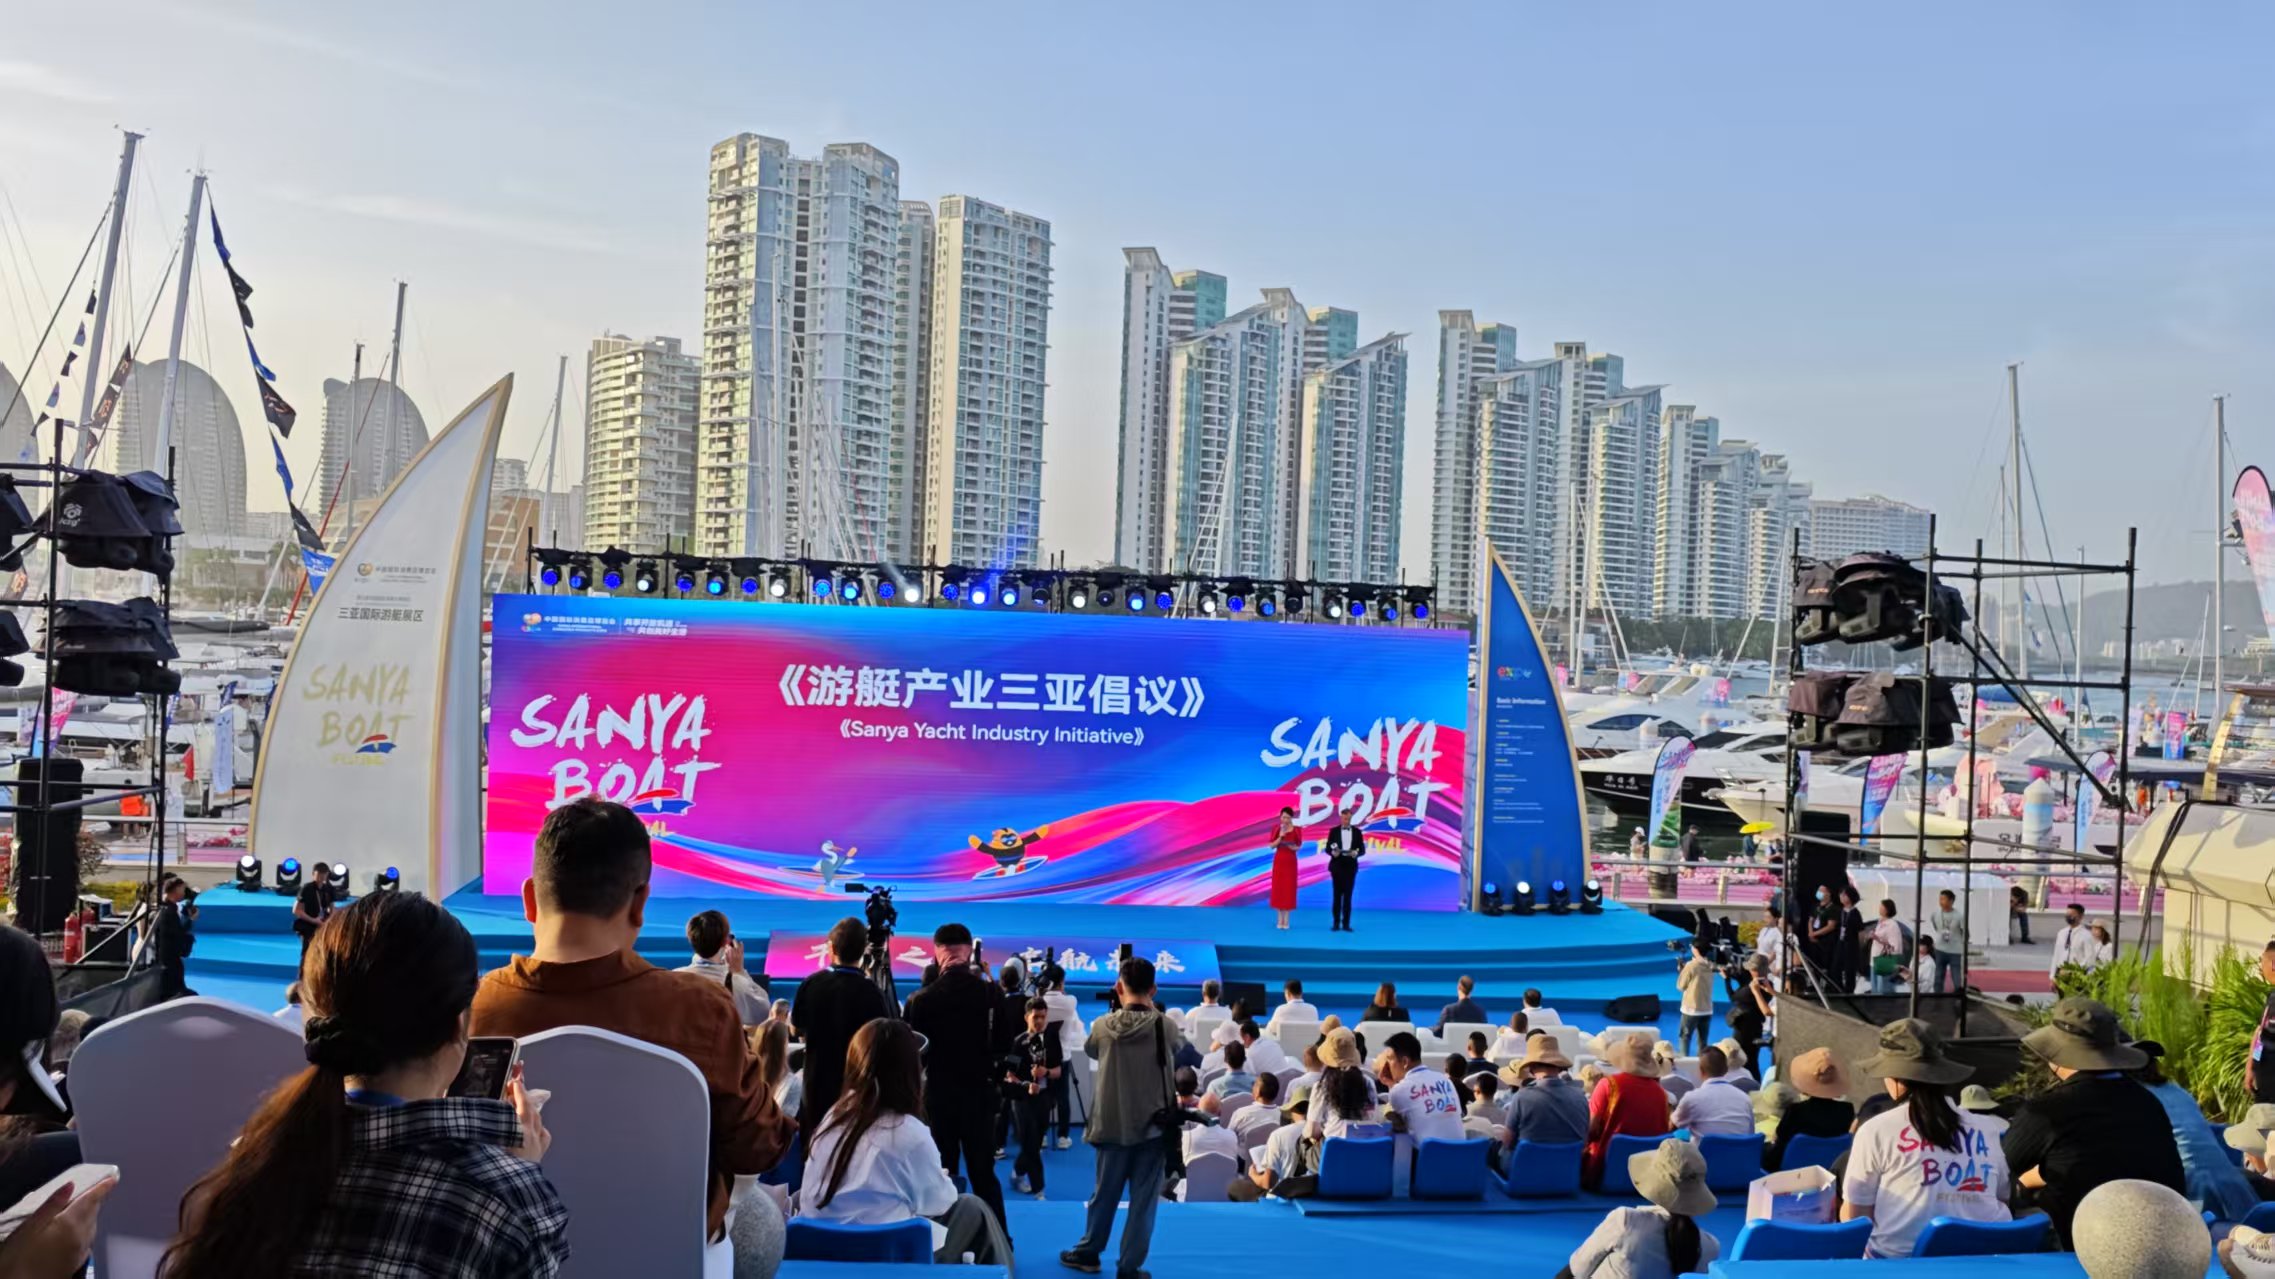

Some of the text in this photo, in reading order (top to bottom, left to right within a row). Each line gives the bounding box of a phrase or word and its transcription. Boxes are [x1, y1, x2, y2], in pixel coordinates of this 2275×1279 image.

[338, 607, 424, 622] 三亚国际游艇展区
[303, 661, 410, 706] SANYA
[779, 664, 1204, 718] 《游艇产业三亚倡议》
[318, 710, 416, 749] BOAT
[510, 692, 712, 754] SANYA
[914, 722, 966, 740] Yacht
[972, 724, 1049, 746] Industry
[1260, 716, 1443, 775] SANYA
[545, 756, 722, 815] BOAT
[1292, 776, 1451, 832] BOAT
[1317, 838, 1408, 854] FIVAL
[1921, 1158, 1993, 1188] BOAT
